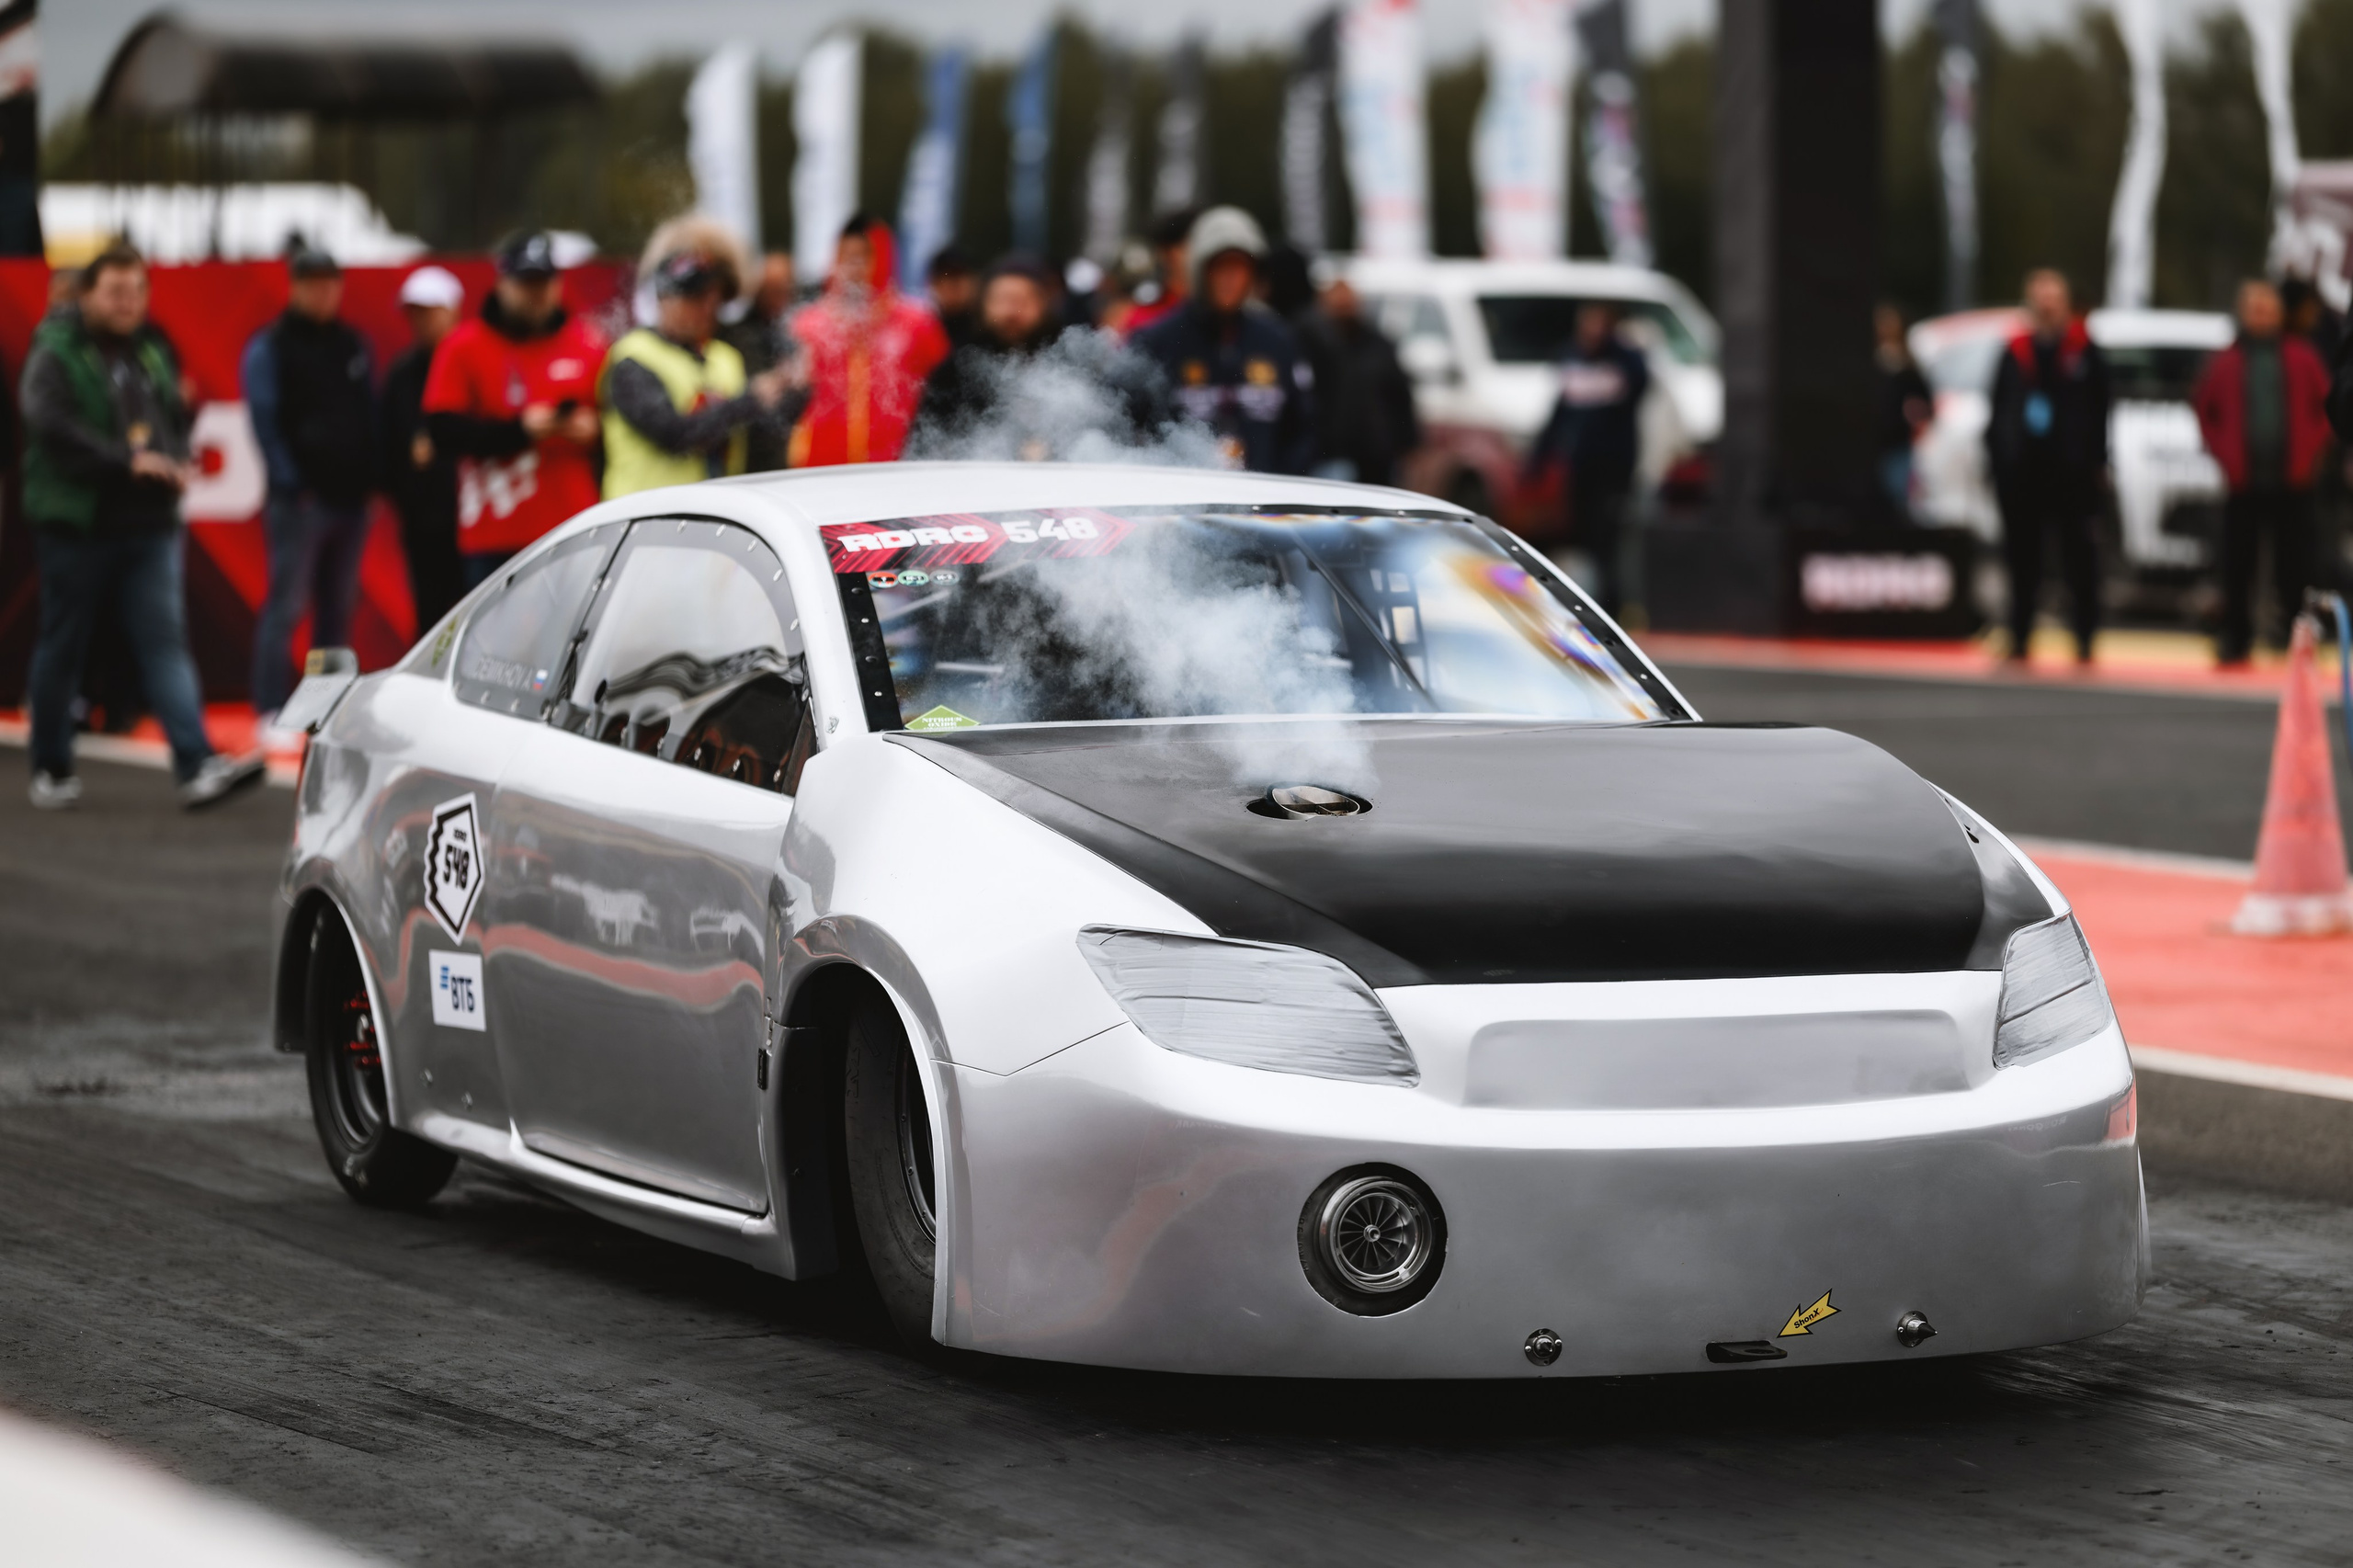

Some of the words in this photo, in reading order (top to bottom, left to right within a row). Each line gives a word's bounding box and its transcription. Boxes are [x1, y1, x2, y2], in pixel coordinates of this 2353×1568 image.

[837, 525, 989, 552] RDRC
[1001, 517, 1099, 542] 548
[443, 843, 470, 890] 548
[451, 975, 474, 1012] ВТБ
[1793, 1307, 1820, 1329] ShonX
